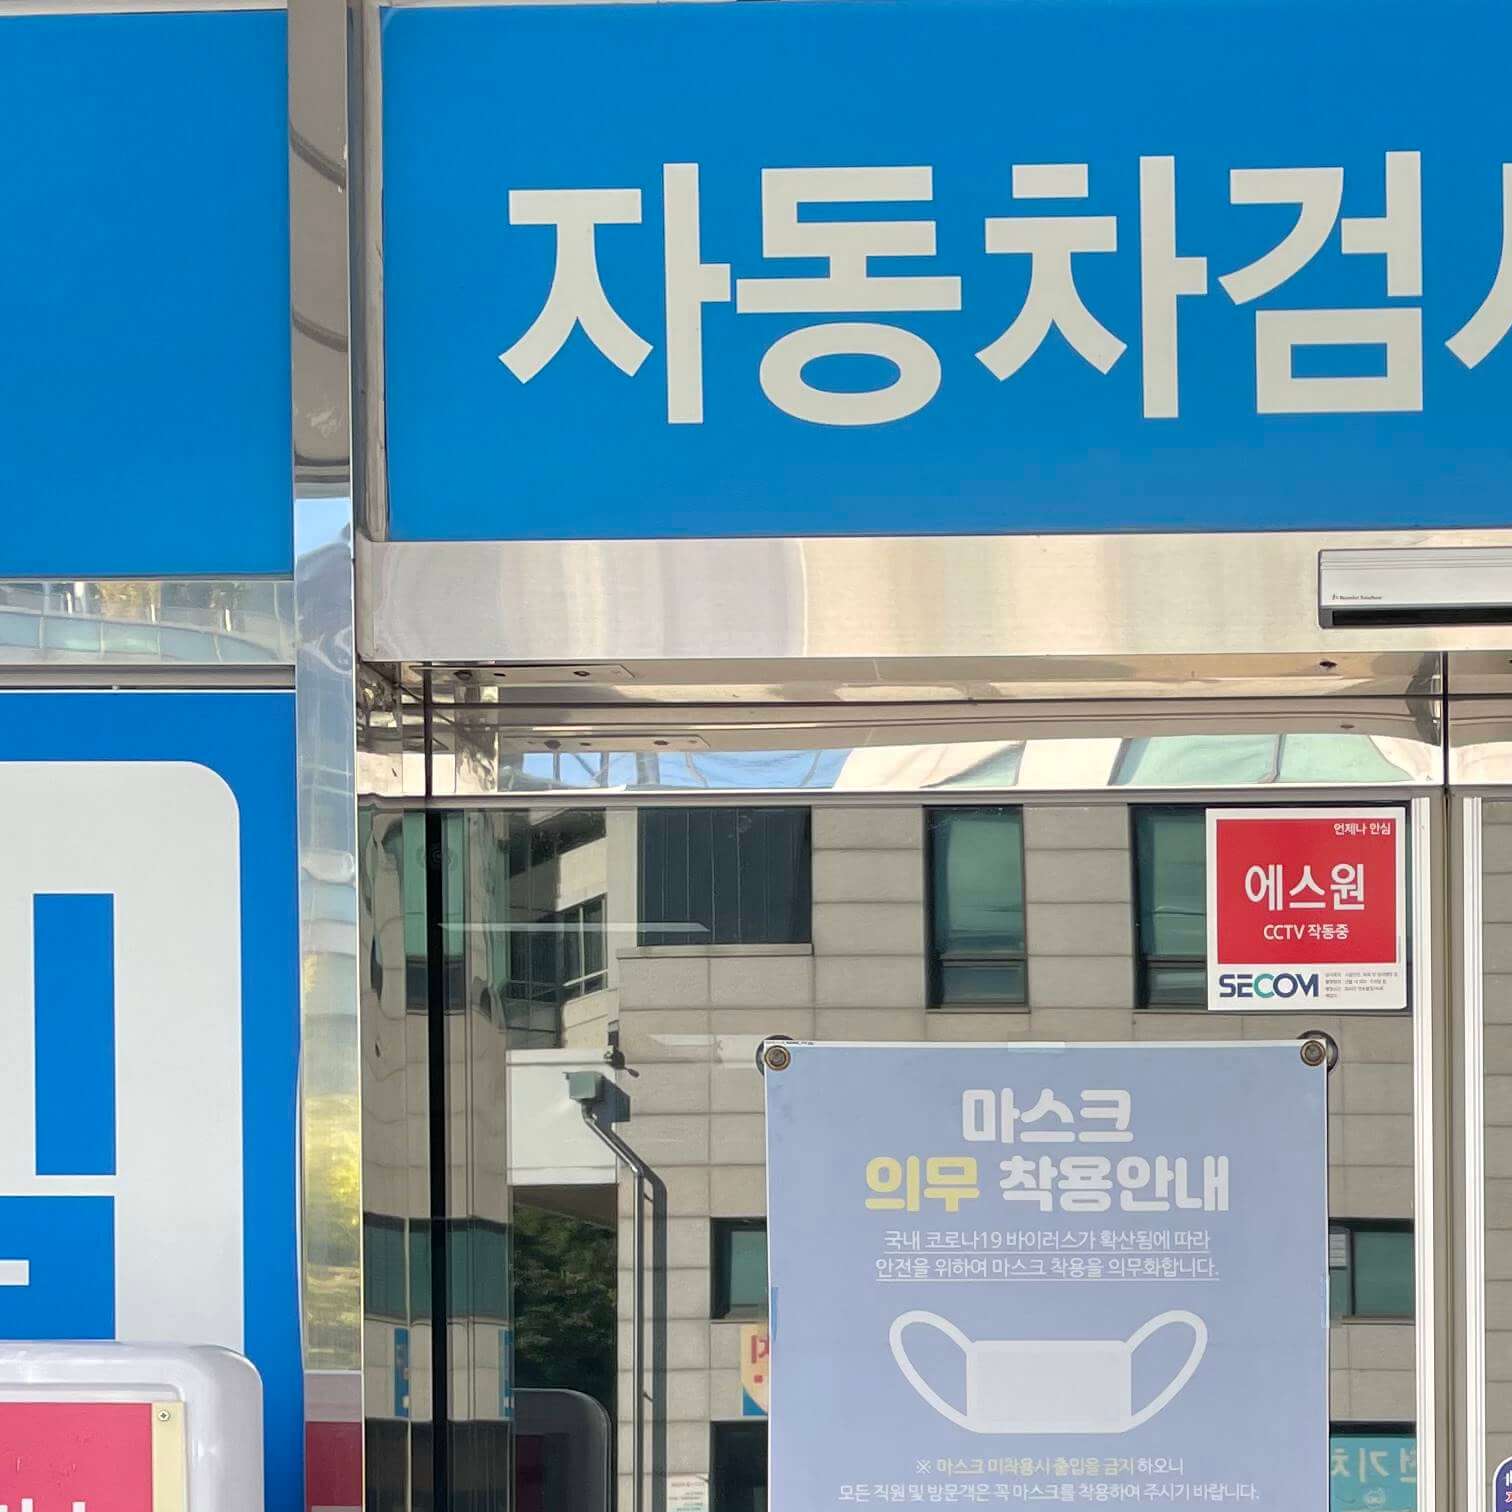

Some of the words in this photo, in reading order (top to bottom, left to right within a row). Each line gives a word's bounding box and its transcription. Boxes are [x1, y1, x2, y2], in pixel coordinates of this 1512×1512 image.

[1334, 823, 1367, 836] 언제나
[1369, 822, 1391, 836] 안심
[1244, 864, 1365, 911] 에스원
[1263, 925, 1305, 940] CCTV
[1307, 924, 1349, 940] 작동중
[1219, 973, 1319, 998] SECOM
[961, 1087, 1134, 1143] 마스크
[864, 1156, 981, 1212] 의무
[999, 1155, 1229, 1212] 착용안내
[884, 1230, 921, 1250] 국내
[926, 1231, 1002, 1250] 코로나19
[1007, 1230, 1096, 1250] 바이러스가
[1100, 1230, 1171, 1250] 확산됨에
[1175, 1230, 1210, 1250] 따라
[875, 1258, 931, 1278] 안전을
[934, 1258, 987, 1278] 위하여
[993, 1258, 1047, 1277] 마스크
[1051, 1257, 1103, 1278] 착용을
[1108, 1257, 1219, 1278] 의무화합니다.
[937, 1458, 985, 1476] 마스크
[988, 1458, 1050, 1476] 미착용시
[1053, 1458, 1100, 1477] 출입을
[1102, 1458, 1134, 1477] 금지
[1138, 1458, 1184, 1476] 하오니
[838, 1485, 870, 1502] 모든
[874, 1484, 905, 1502] 직원
[927, 1484, 990, 1502] 방문객은
[1013, 1484, 1076, 1502] 마스크를
[1079, 1484, 1141, 1502] 착용하여
[1144, 1484, 1190, 1502] 주시기
[1193, 1483, 1260, 1502] 바랍니다.
